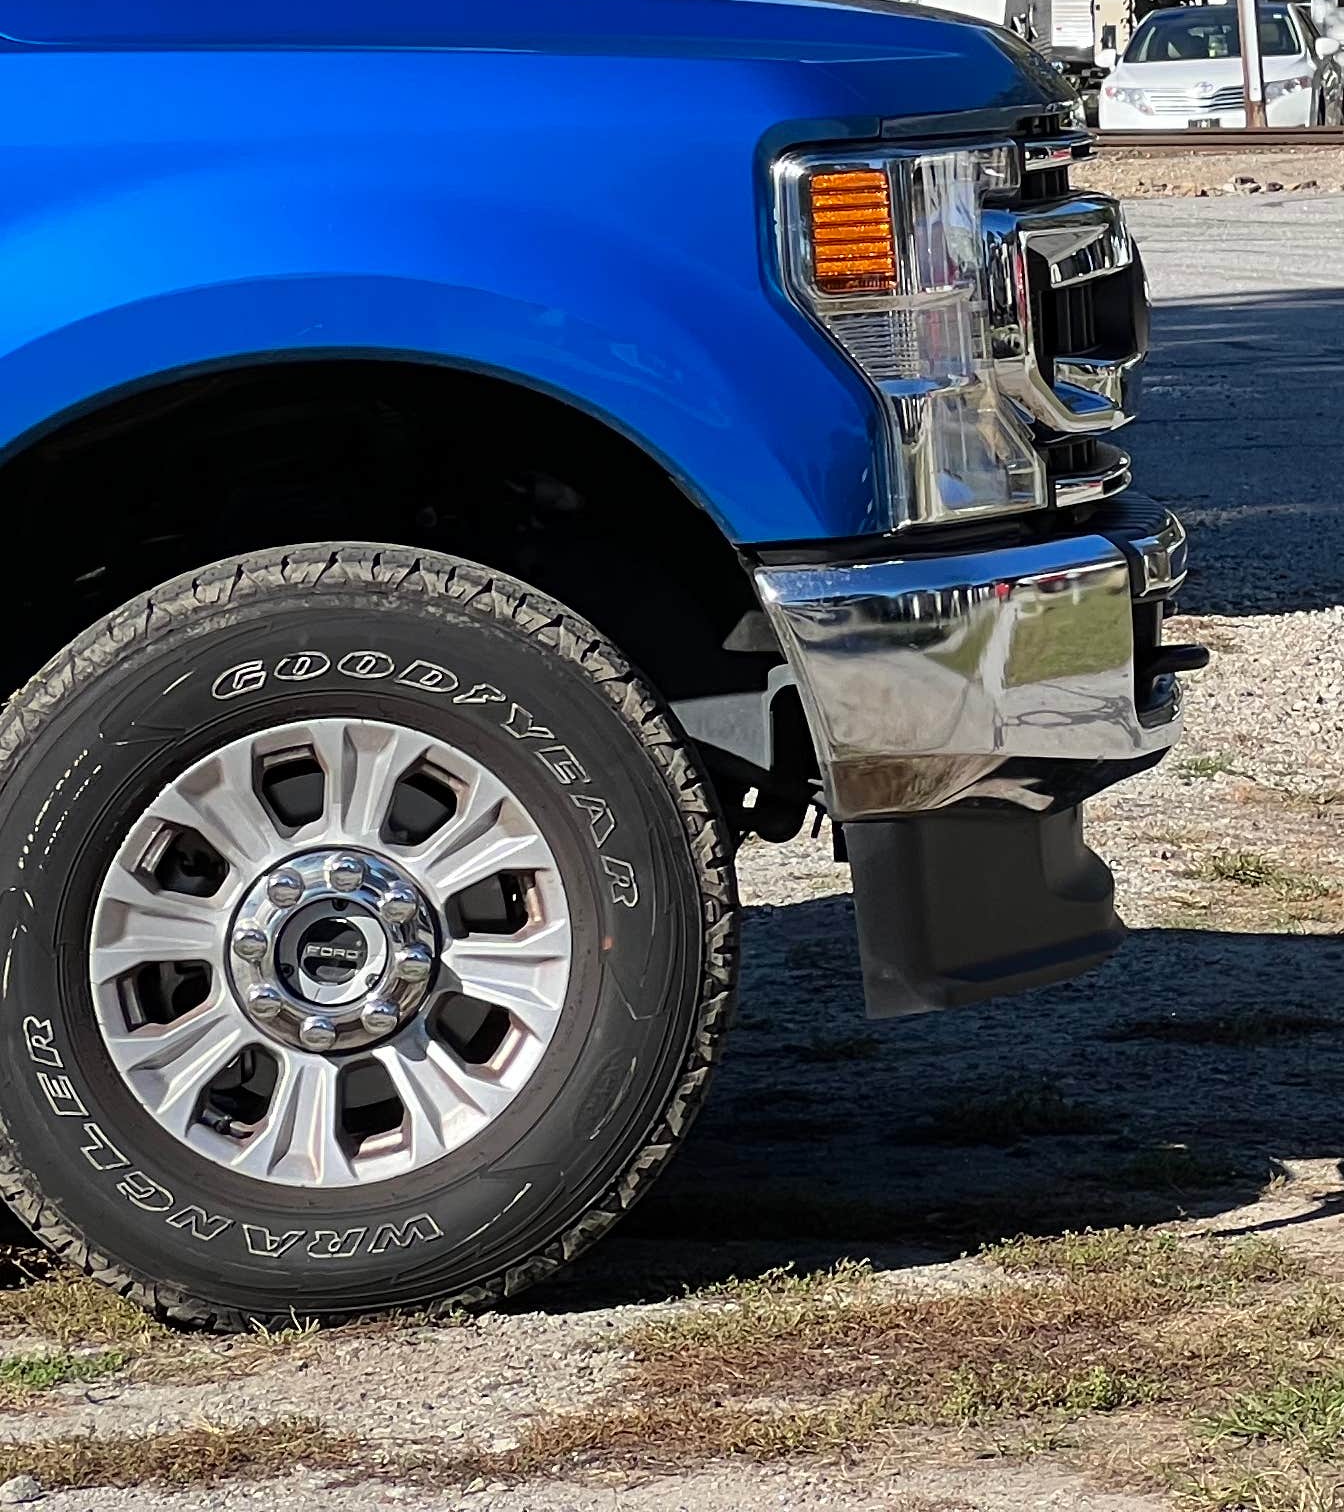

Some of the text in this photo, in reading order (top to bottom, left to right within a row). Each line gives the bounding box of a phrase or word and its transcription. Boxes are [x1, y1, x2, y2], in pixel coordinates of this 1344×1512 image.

[211, 650, 641, 909] GOODYEAR
[307, 944, 359, 960] FORD
[22, 1014, 445, 1259] WRANGLER
